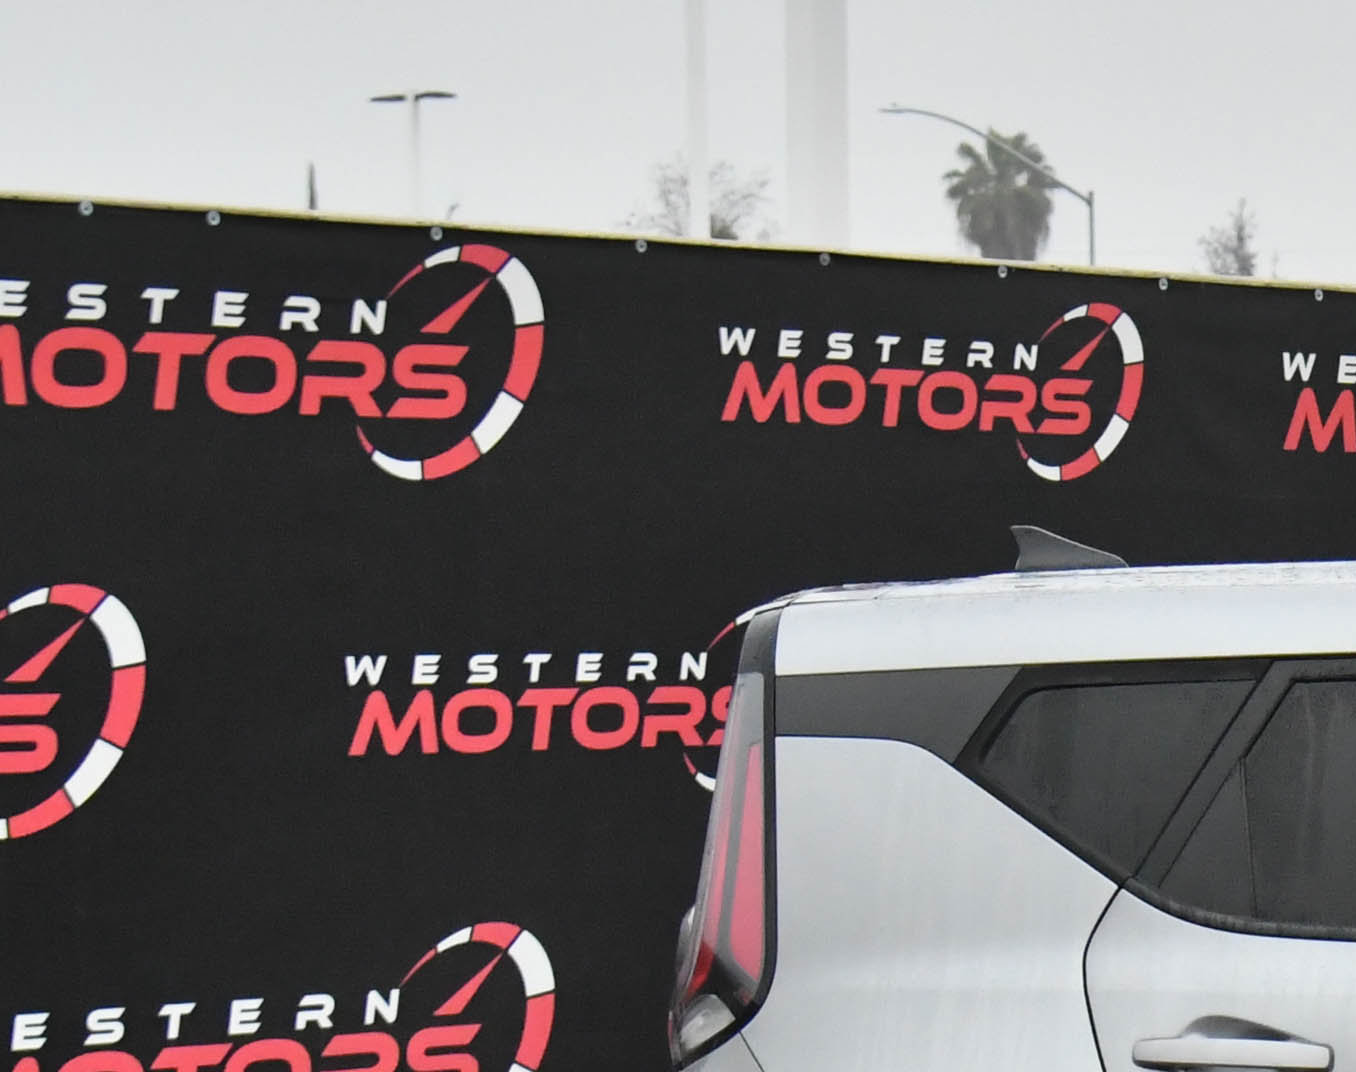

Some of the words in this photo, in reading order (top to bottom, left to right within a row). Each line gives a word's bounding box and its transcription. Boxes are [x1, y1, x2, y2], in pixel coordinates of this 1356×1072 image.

[0, 324, 470, 420] OTORS
[719, 326, 1039, 371] WESTERN
[722, 361, 1093, 435] MOTORS
[345, 651, 708, 686] WESTERN
[10, 988, 401, 1052] ESTERN
